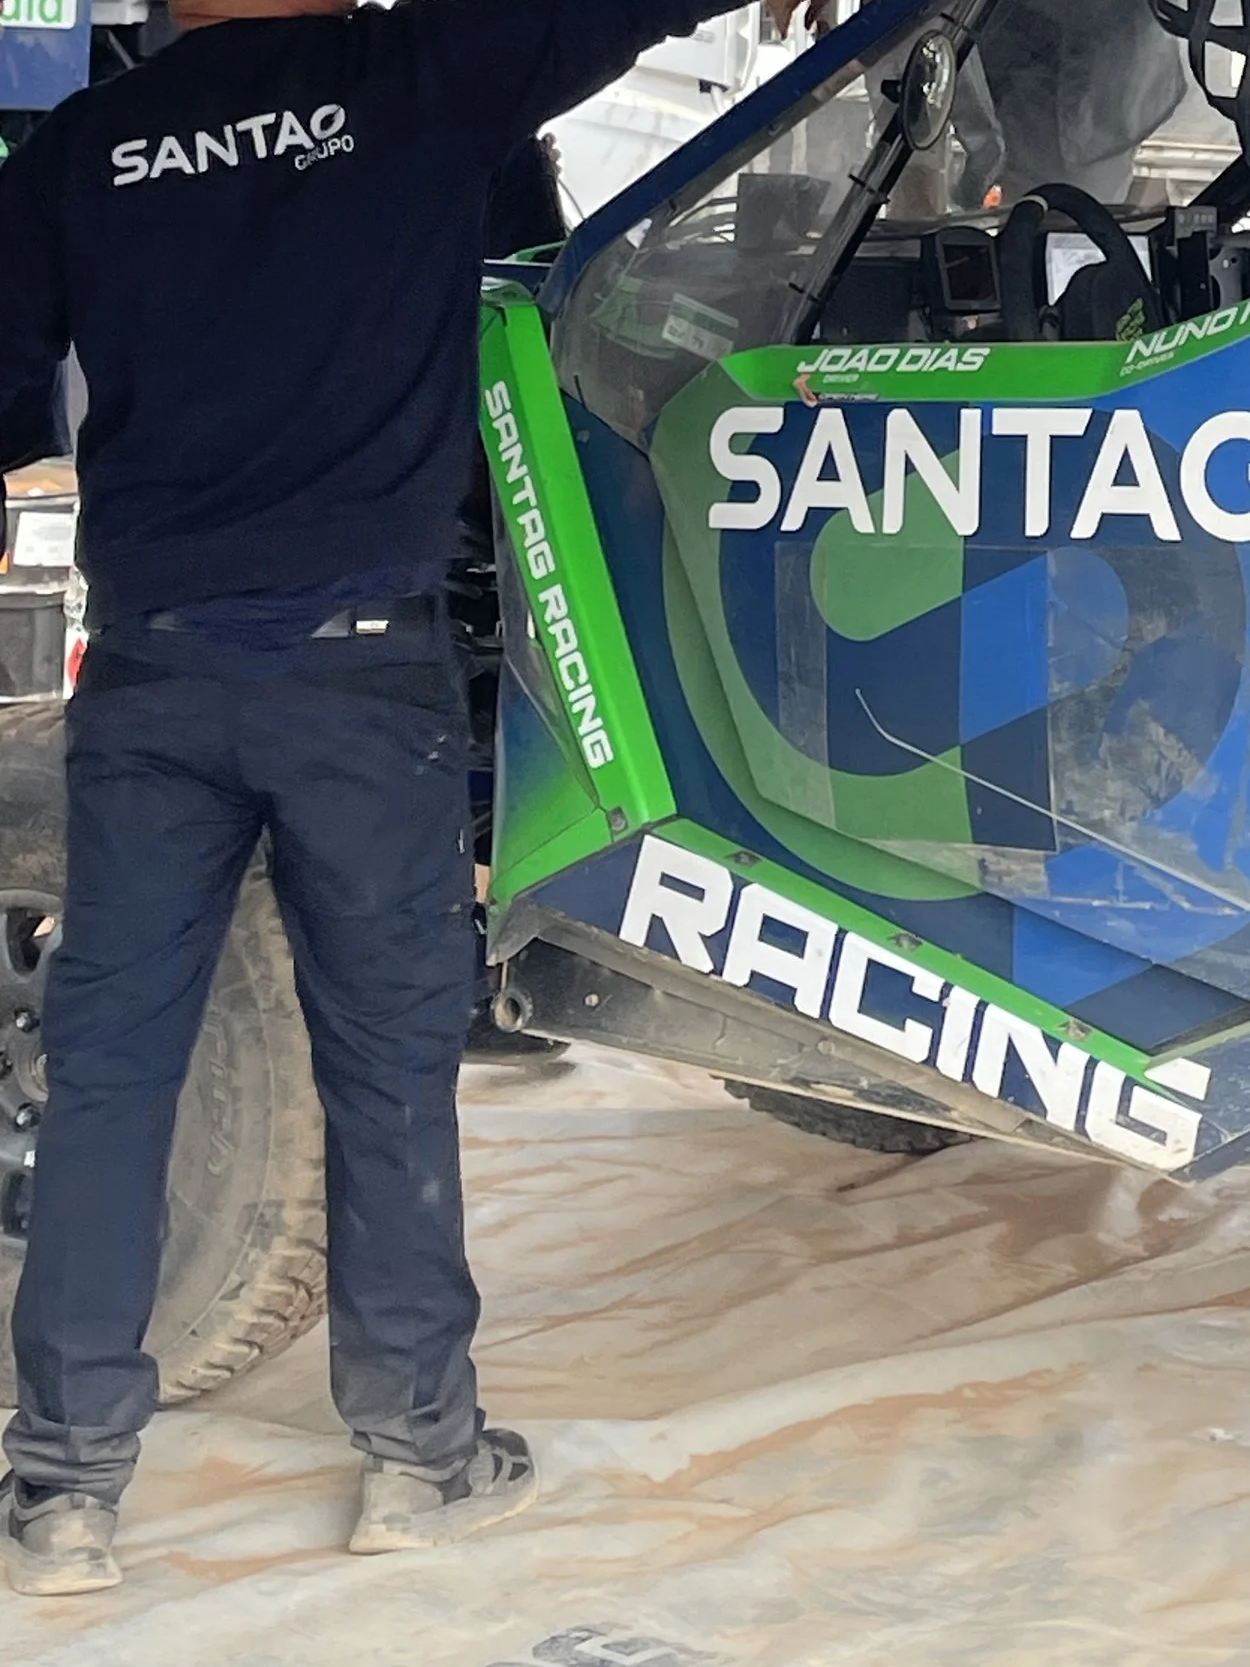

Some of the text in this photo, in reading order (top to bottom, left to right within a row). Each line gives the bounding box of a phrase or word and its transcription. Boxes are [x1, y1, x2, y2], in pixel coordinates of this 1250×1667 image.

[796, 347, 991, 373] JOAO DIAS
[1125, 307, 1239, 364] NUNO
[485, 380, 614, 770] SANTAG RACING
[618, 833, 1212, 1172] RACING
